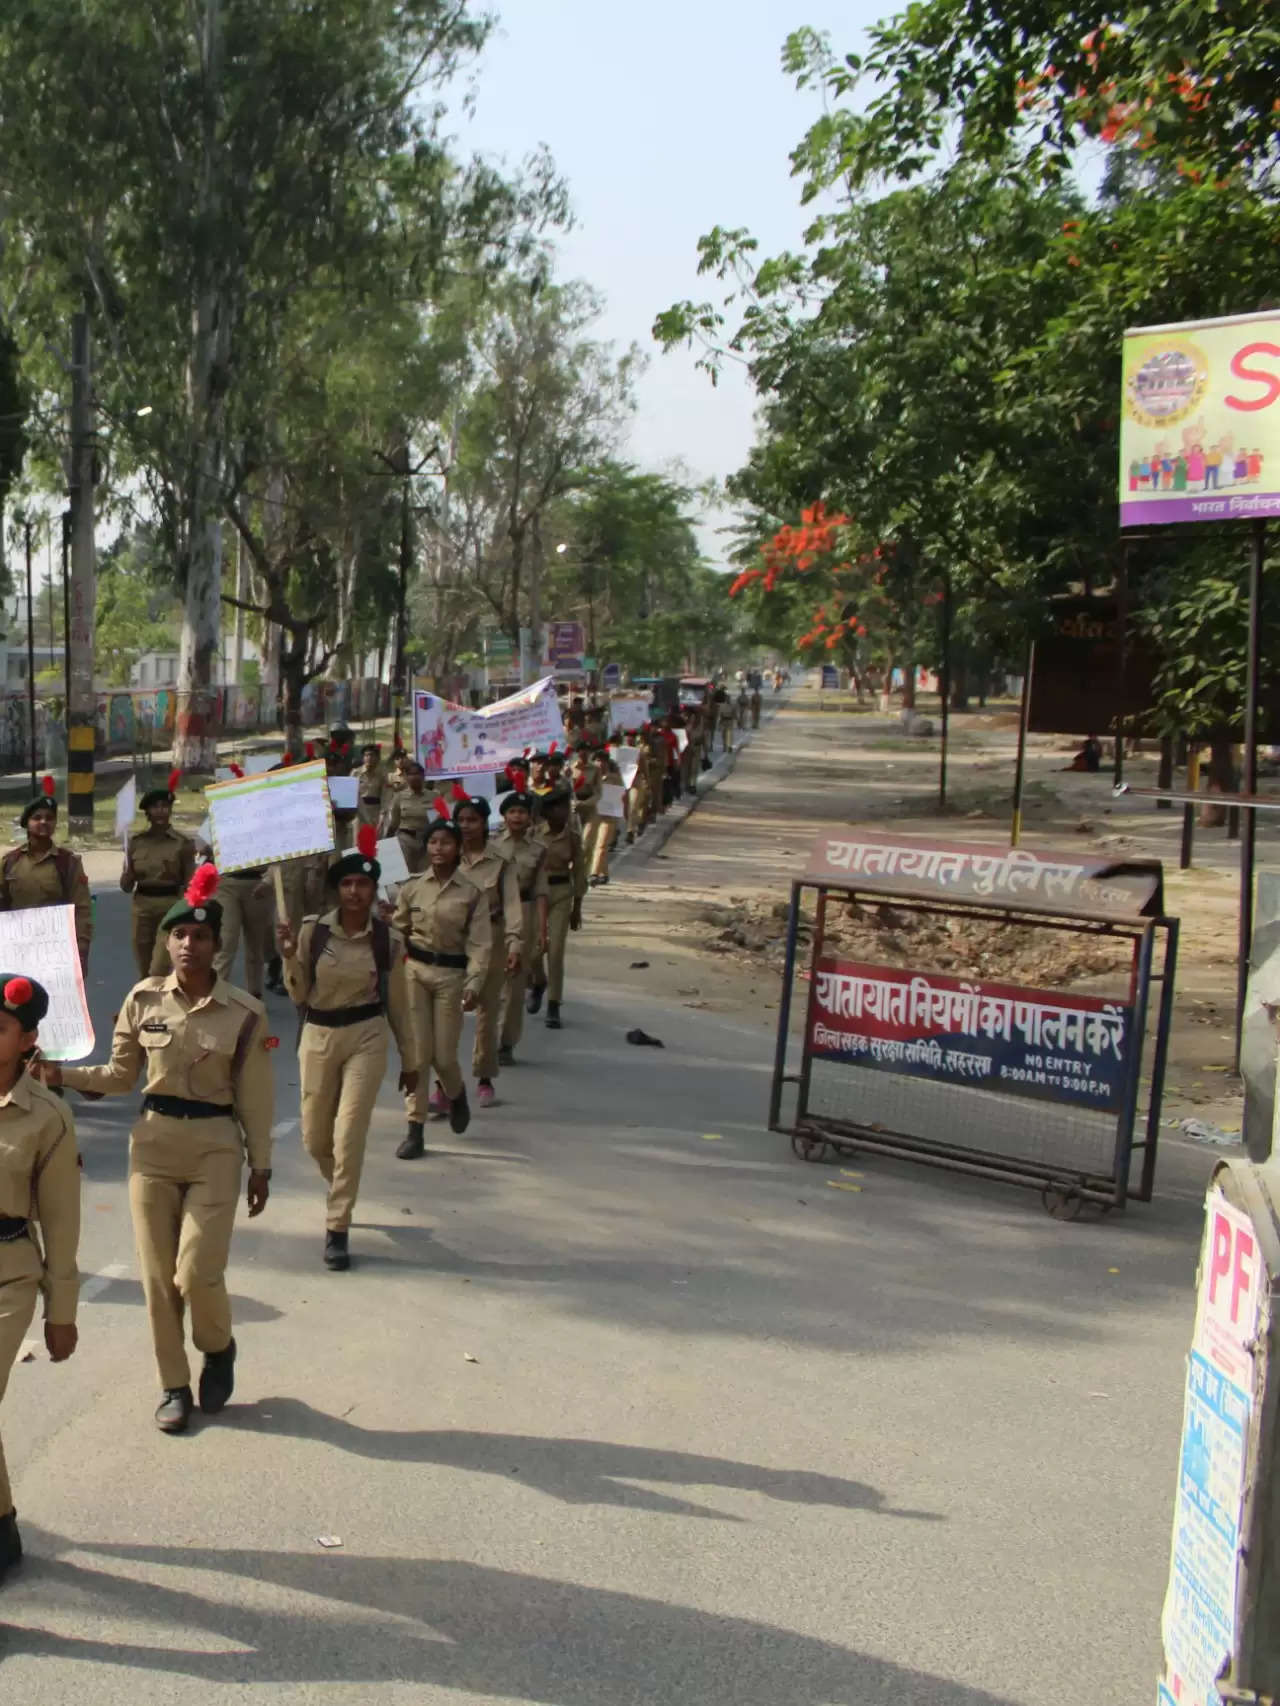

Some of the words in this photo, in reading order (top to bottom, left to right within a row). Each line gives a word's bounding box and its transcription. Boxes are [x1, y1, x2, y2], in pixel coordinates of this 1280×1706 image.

[1192, 501, 1227, 514] भारत
[825, 840, 969, 884] यातायात
[970, 850, 1084, 897] पुलिस
[815, 971, 910, 1026] यातायात
[907, 976, 981, 1037] नियमों
[977, 994, 1014, 1042] का
[1014, 1000, 1087, 1053] पालन
[1082, 1003, 1126, 1062] करें
[813, 1021, 842, 1049] जिला
[840, 1030, 870, 1057] सड़क
[868, 1034, 906, 1063] सुरक्षा
[944, 1048, 993, 1078] सहरसा
[1024, 1053, 1043, 1069] NO
[1045, 1056, 1092, 1077] ENTRY
